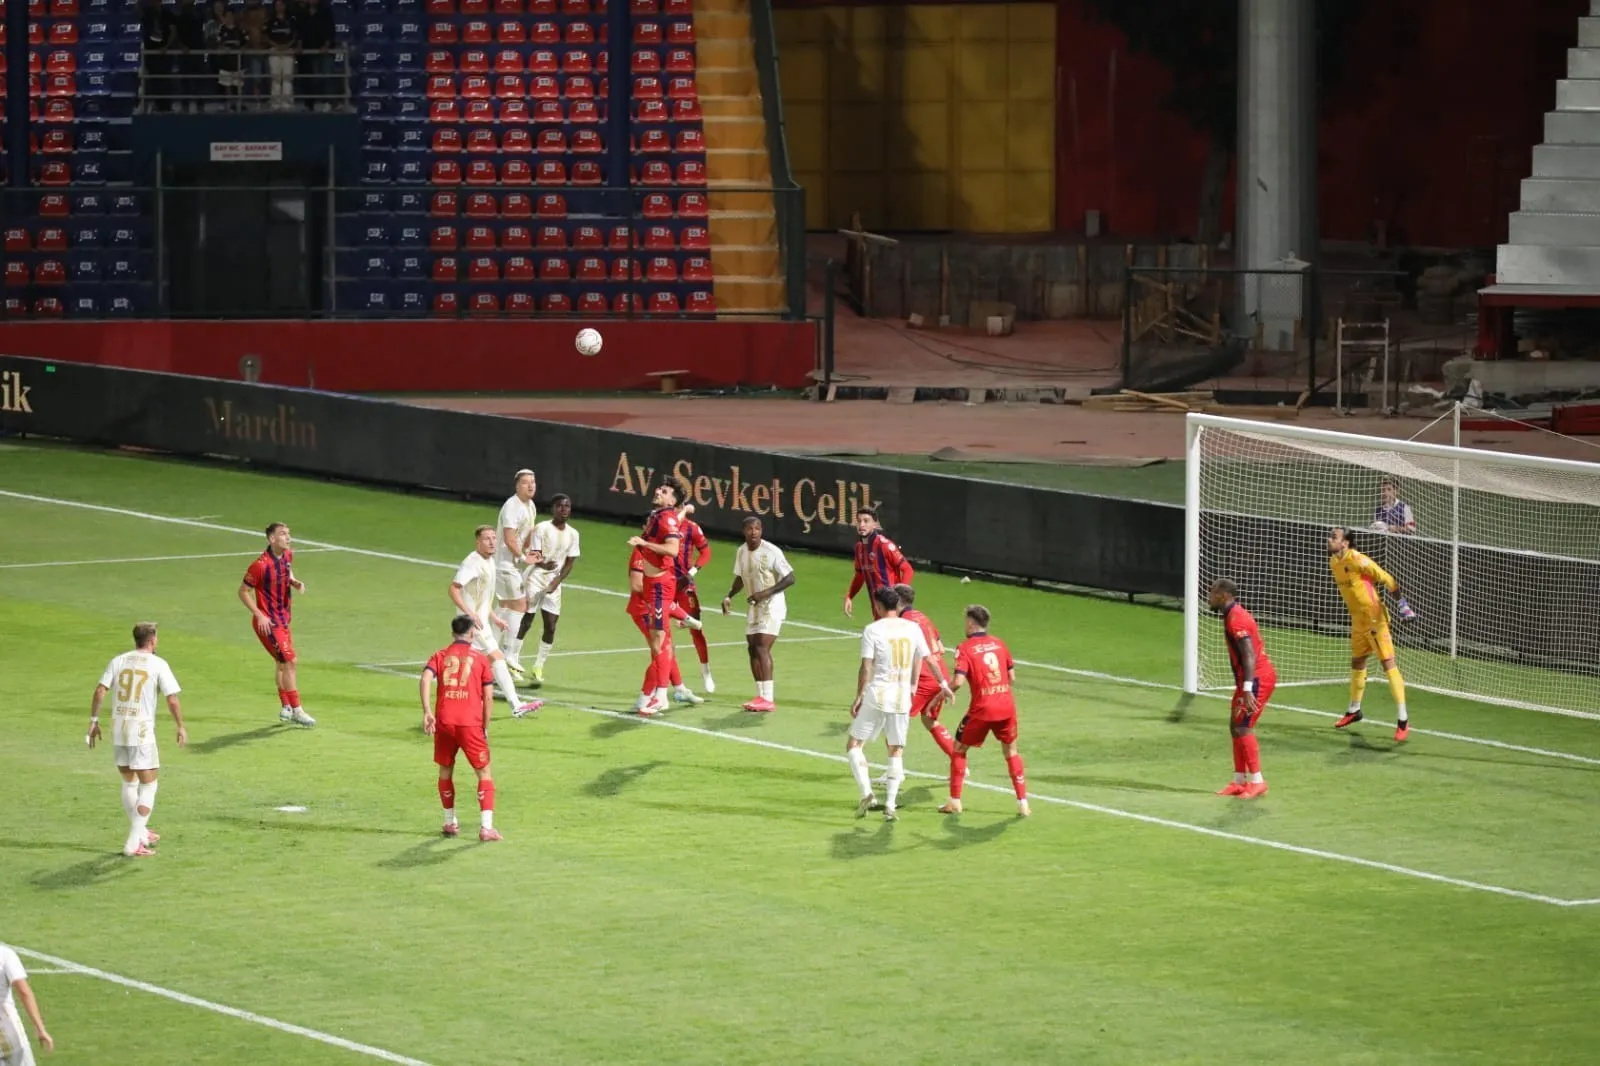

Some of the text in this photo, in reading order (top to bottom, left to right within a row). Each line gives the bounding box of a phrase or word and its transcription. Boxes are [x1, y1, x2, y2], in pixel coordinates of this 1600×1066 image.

[204, 397, 318, 449] Mardin
[888, 638, 911, 669] 10
[983, 652, 1001, 684] 9
[118, 668, 148, 703] 97
